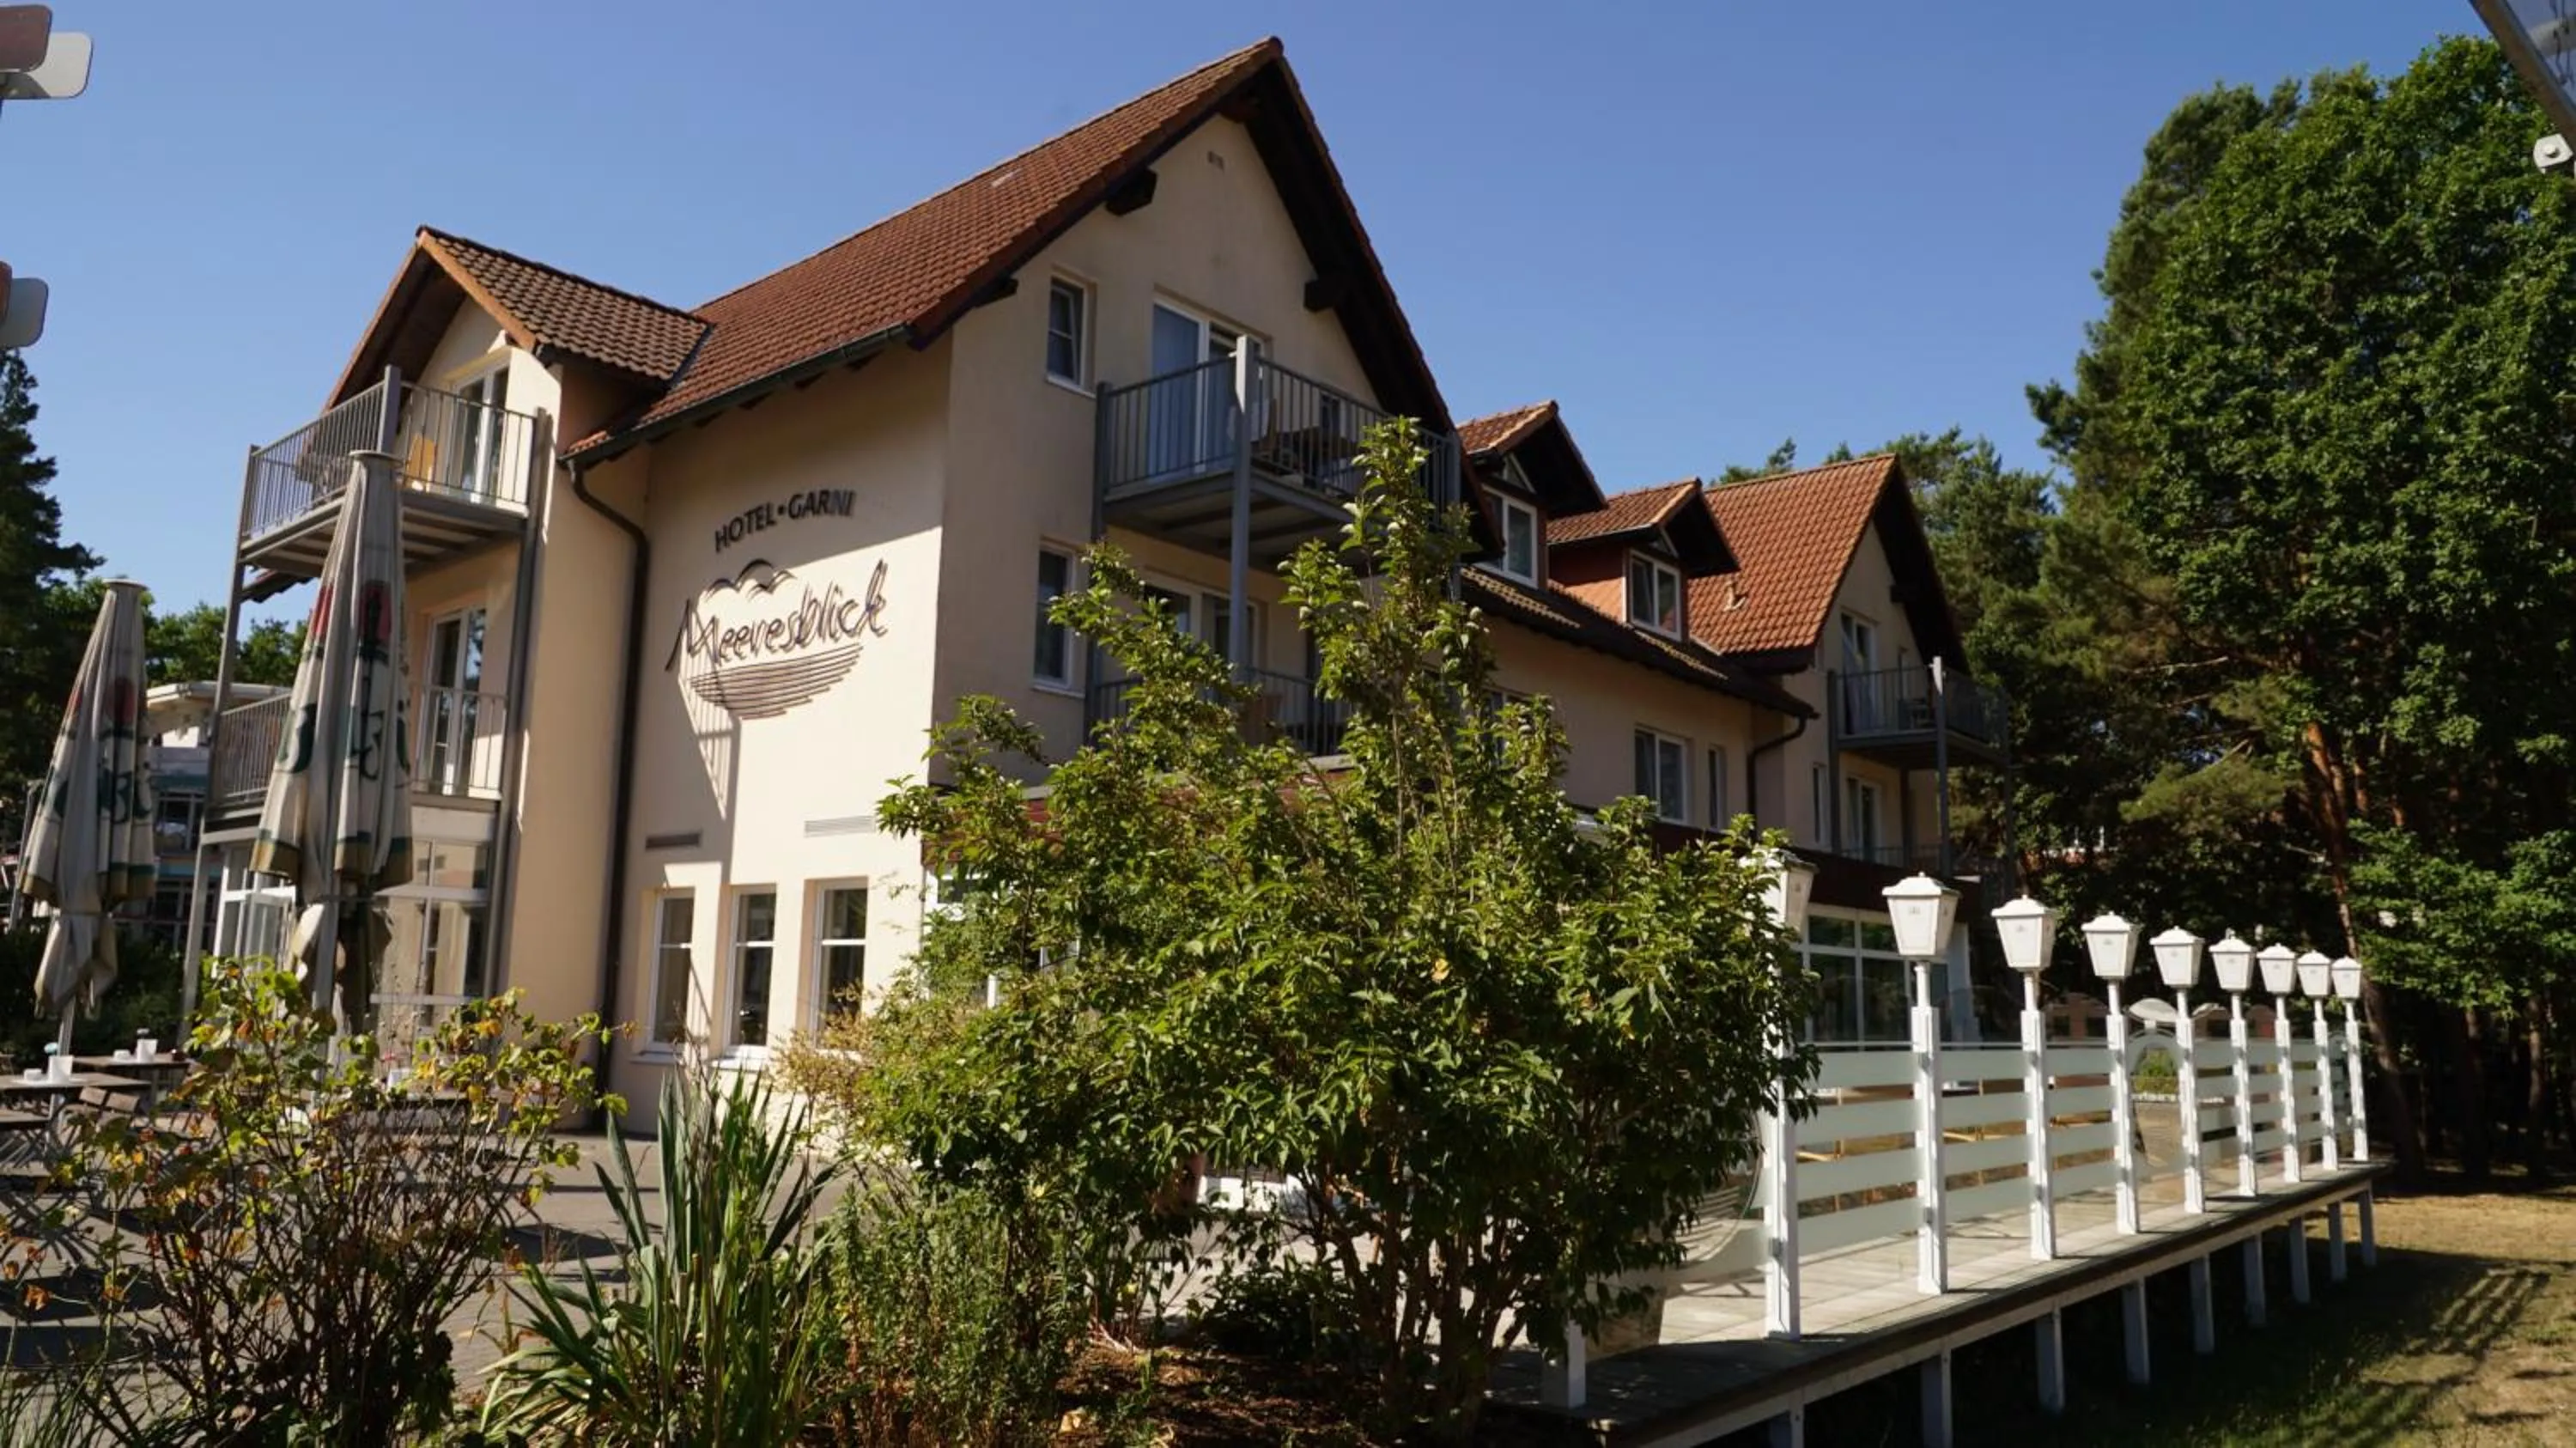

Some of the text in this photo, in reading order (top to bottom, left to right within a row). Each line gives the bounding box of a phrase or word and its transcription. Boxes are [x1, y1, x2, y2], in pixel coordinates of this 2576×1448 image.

[714, 489, 857, 553] HOTEL GARNI
[665, 558, 889, 672] Meeresblick
